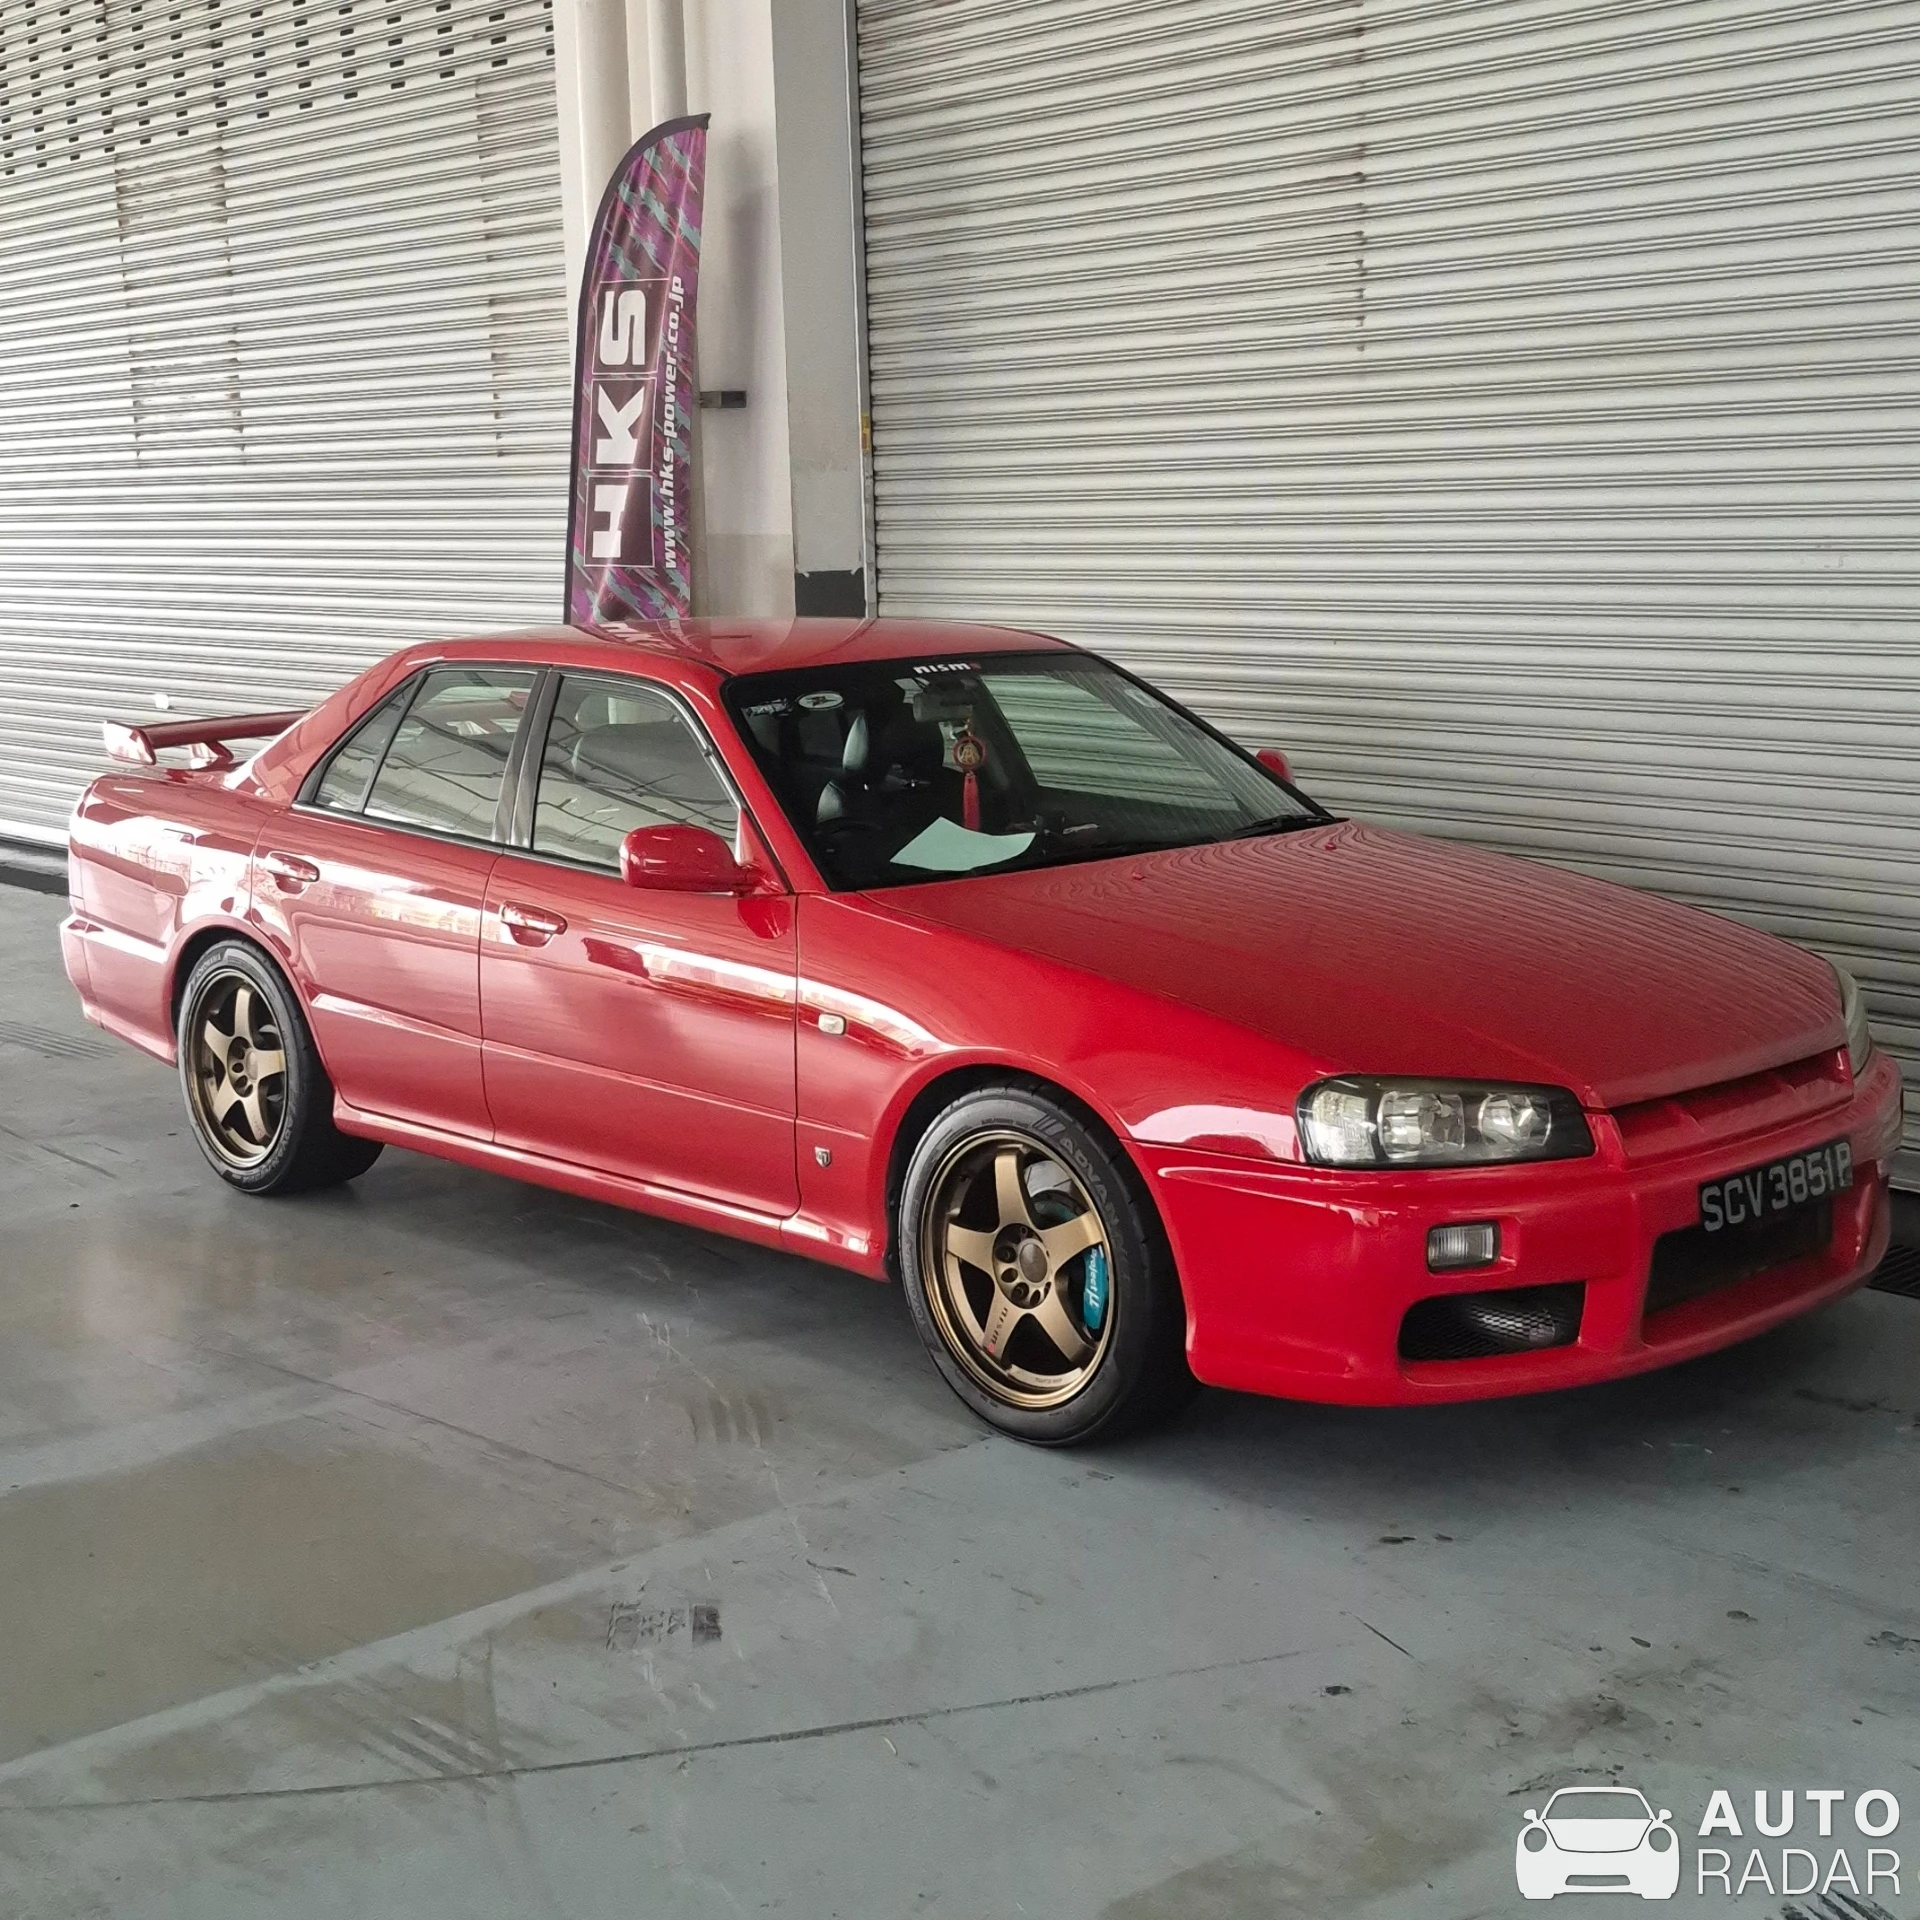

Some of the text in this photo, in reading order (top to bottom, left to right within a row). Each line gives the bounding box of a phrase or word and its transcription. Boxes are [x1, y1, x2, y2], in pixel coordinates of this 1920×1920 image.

[592, 289, 646, 559] HKS
[664, 275, 685, 570] www.hks-power.co.jp
[1701, 1141, 1853, 1232] SCV 3851P
